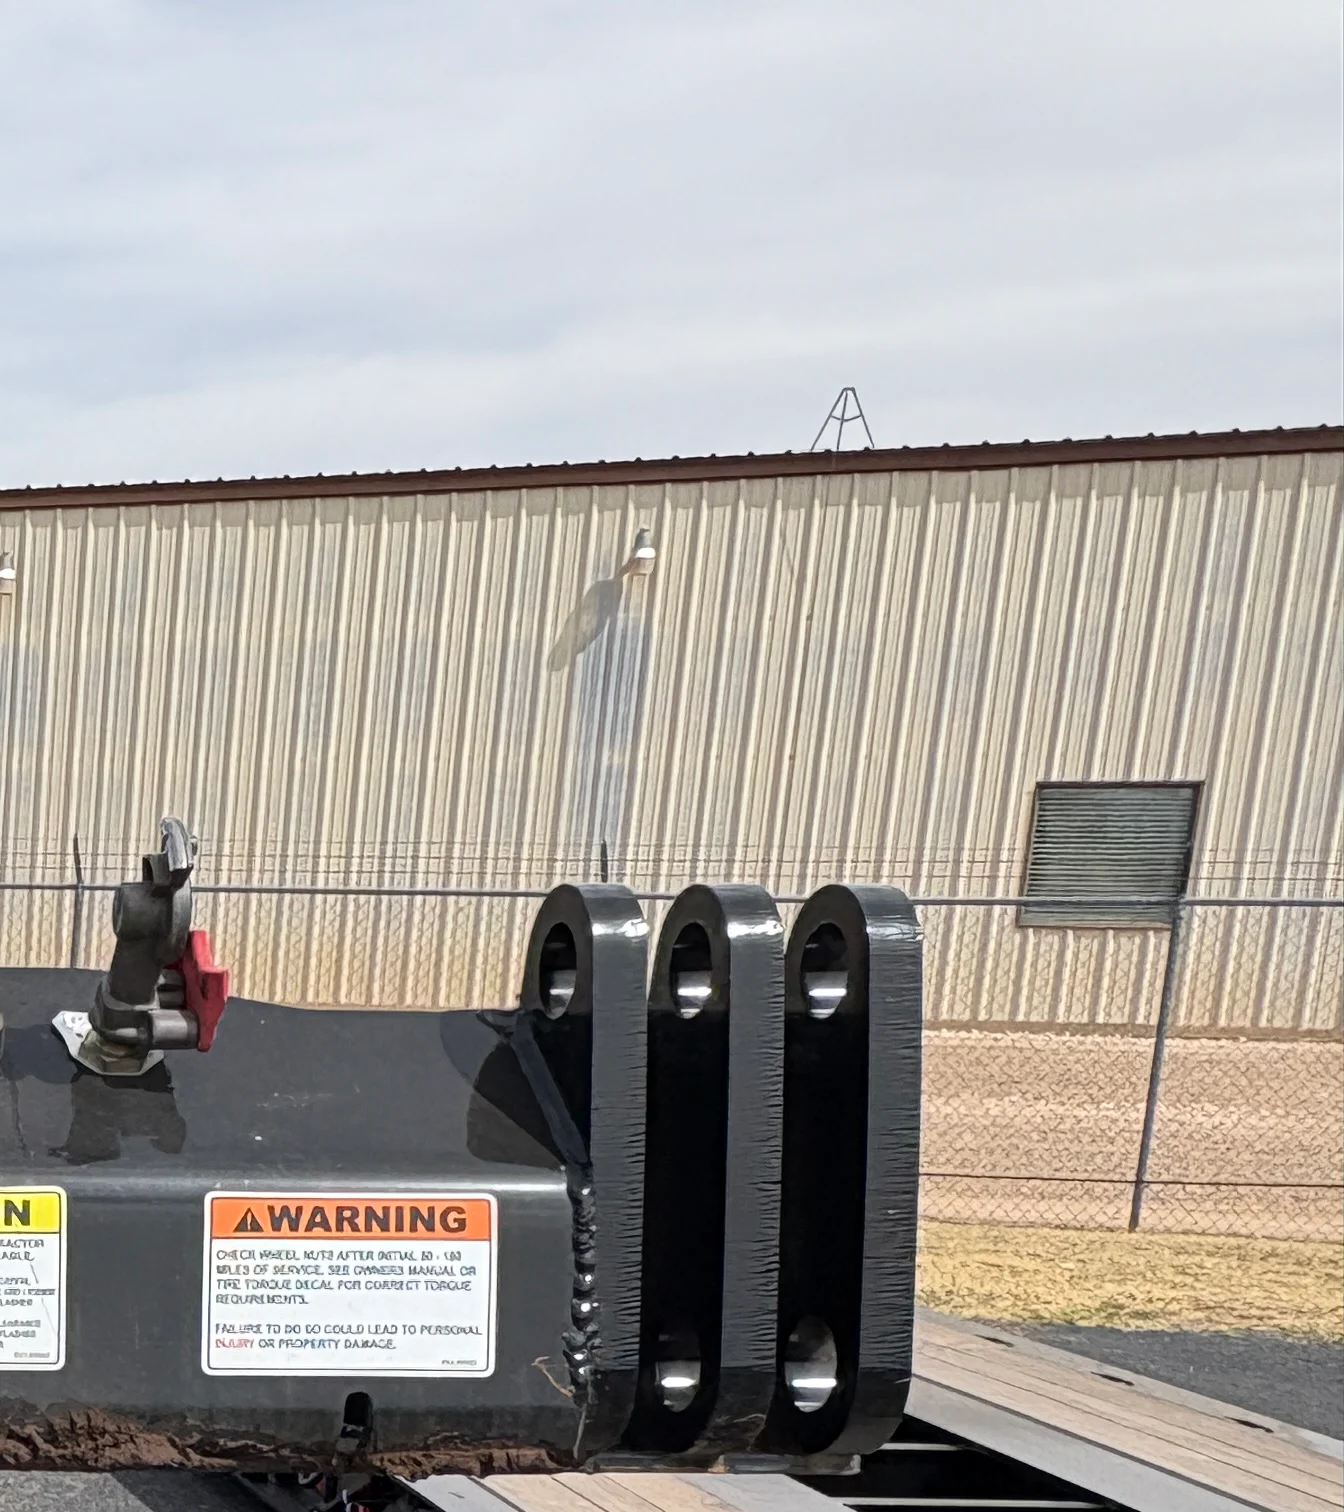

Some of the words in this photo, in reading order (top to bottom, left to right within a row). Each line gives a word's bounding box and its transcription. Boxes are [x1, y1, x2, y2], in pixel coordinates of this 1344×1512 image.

[266, 1204, 467, 1234] WARNING
[336, 1250, 374, 1260] AFTER
[254, 1265, 269, 1275] OF
[460, 1265, 476, 1275] OR
[338, 1279, 361, 1290] FOR
[365, 1279, 421, 1290] CORRECT
[424, 1280, 472, 1291] TORQUE
[266, 1323, 280, 1334] TO
[285, 1323, 301, 1334] DO
[324, 1323, 364, 1334] COULD
[368, 1323, 397, 1334] LEAD
[402, 1324, 416, 1335] TO
[258, 1339, 275, 1349] OR
[278, 1339, 341, 1349] PROPERTY
